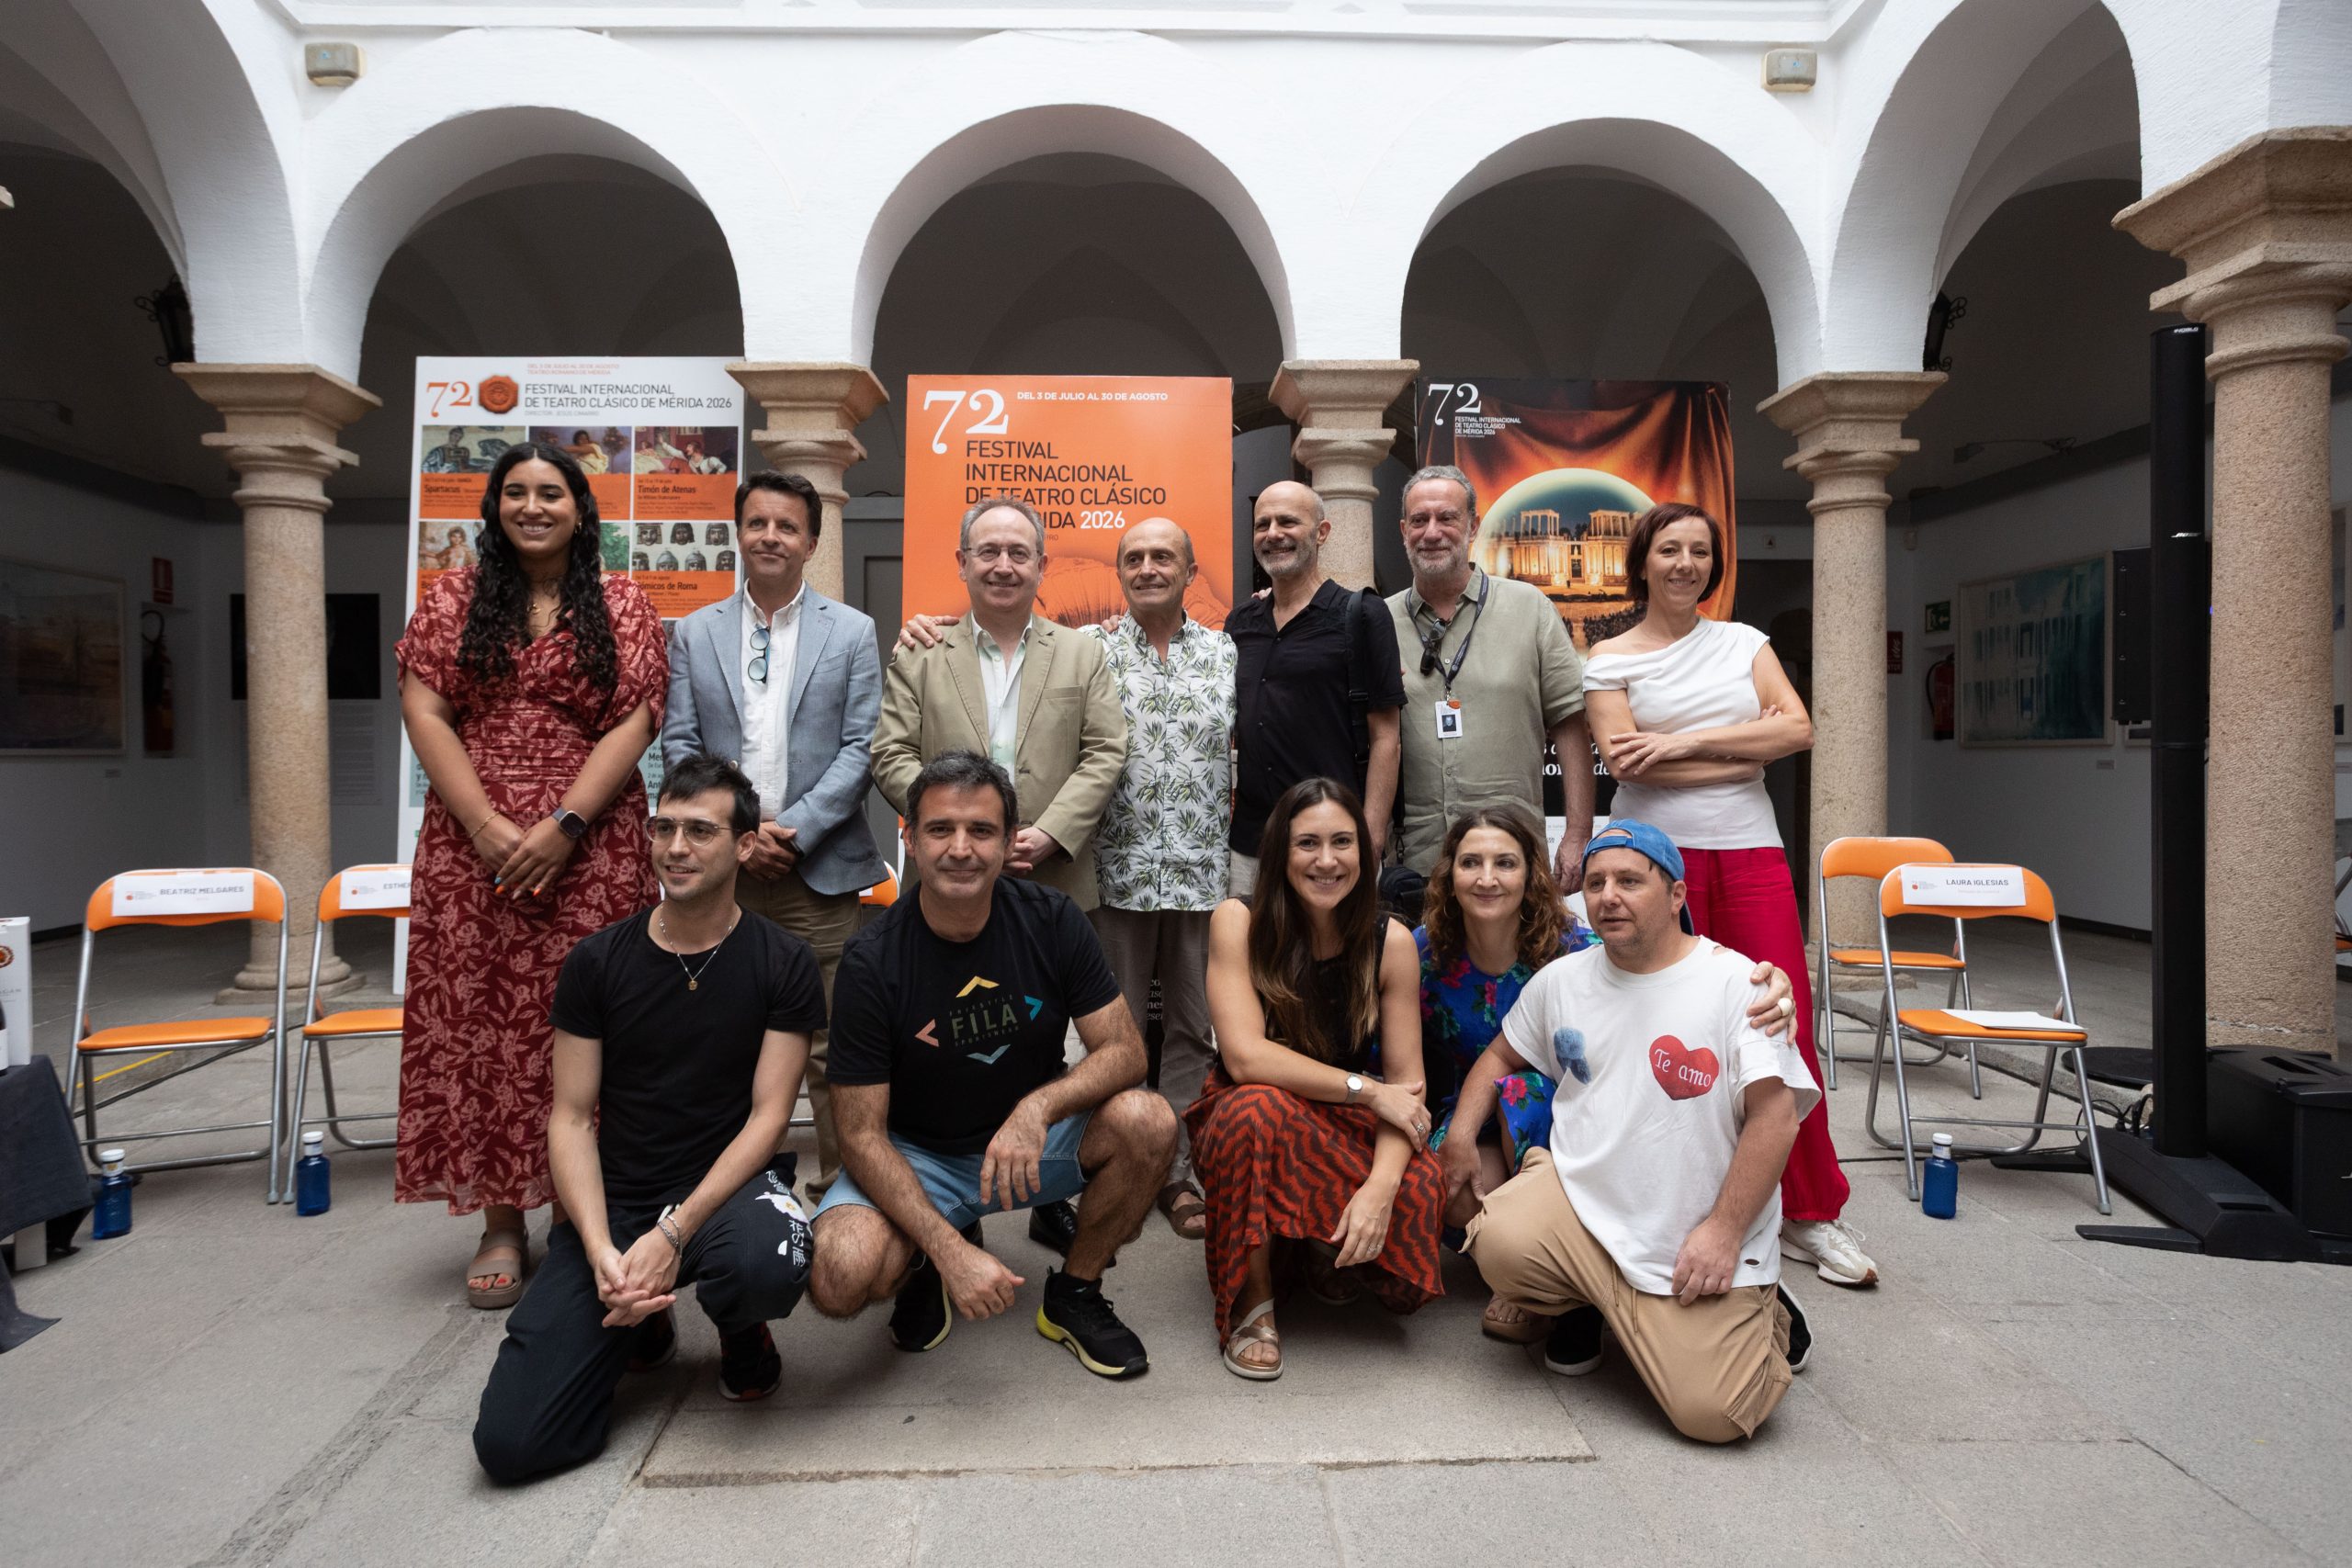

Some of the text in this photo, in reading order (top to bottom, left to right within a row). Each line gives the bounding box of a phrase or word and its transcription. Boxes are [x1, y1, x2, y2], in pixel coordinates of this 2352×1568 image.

[525, 383, 675, 395] FESTIVAL INTERNACIONAL
[1017, 391, 1169, 400] DEL 3 DE JULIO AL 30 DE AGOSTO
[426, 381, 473, 418] 72
[525, 395, 732, 409] DE TEATRO CLÁSICO DE MÉRIDA 2026
[1428, 382, 1482, 426] 72
[923, 389, 1009, 455] 72
[967, 440, 1058, 459] FESTIVAL
[966, 463, 1133, 482] INTERNACIONAL
[638, 484, 696, 493] Timón de Atenas
[966, 487, 990, 504] DE
[1080, 482, 1166, 505] CLÁSICO
[1080, 510, 1126, 529] 2026
[667, 581, 675, 590] de
[677, 581, 697, 590] Roma
[198, 886, 244, 894] MELGARES
[951, 1003, 1018, 1039] FILA
[1654, 1048, 1712, 1088] Te amo
